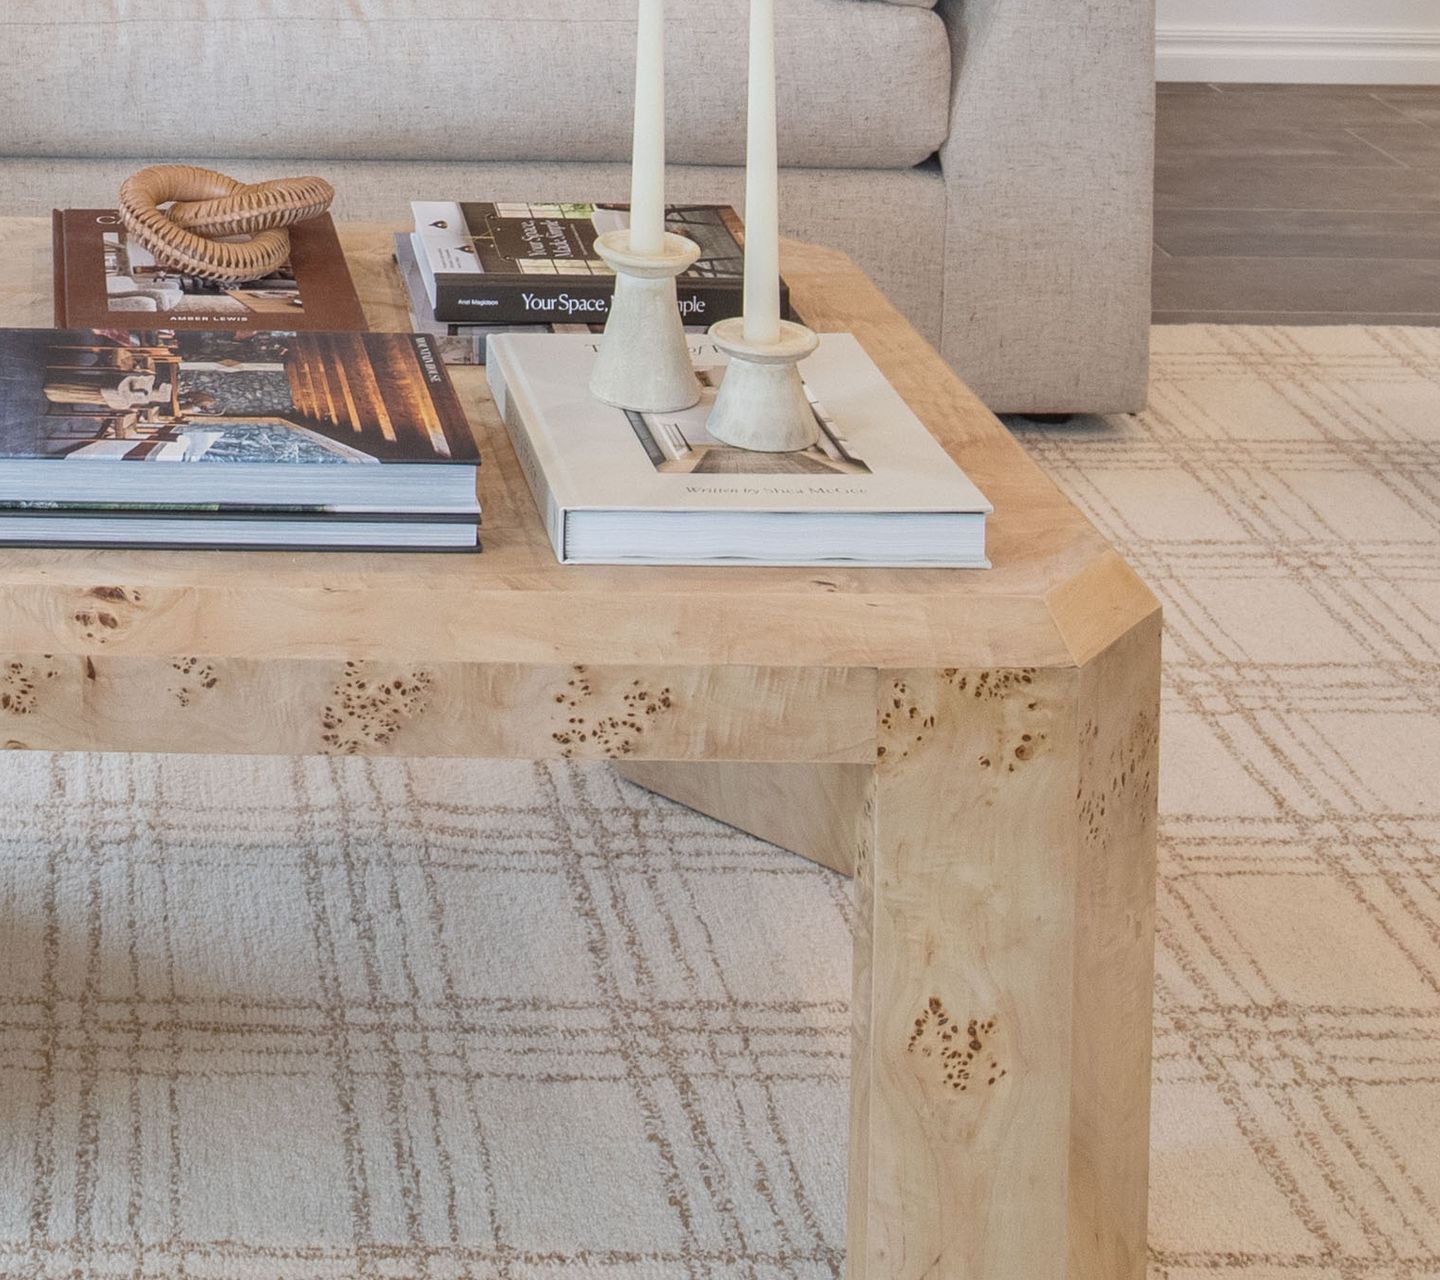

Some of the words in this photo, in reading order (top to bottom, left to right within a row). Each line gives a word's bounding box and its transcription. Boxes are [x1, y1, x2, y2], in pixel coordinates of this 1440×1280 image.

[522, 294, 557, 311] Your
[558, 294, 609, 315] Space,
[677, 295, 706, 316] mple
[686, 486, 738, 494] Written
[743, 487, 759, 495] by
